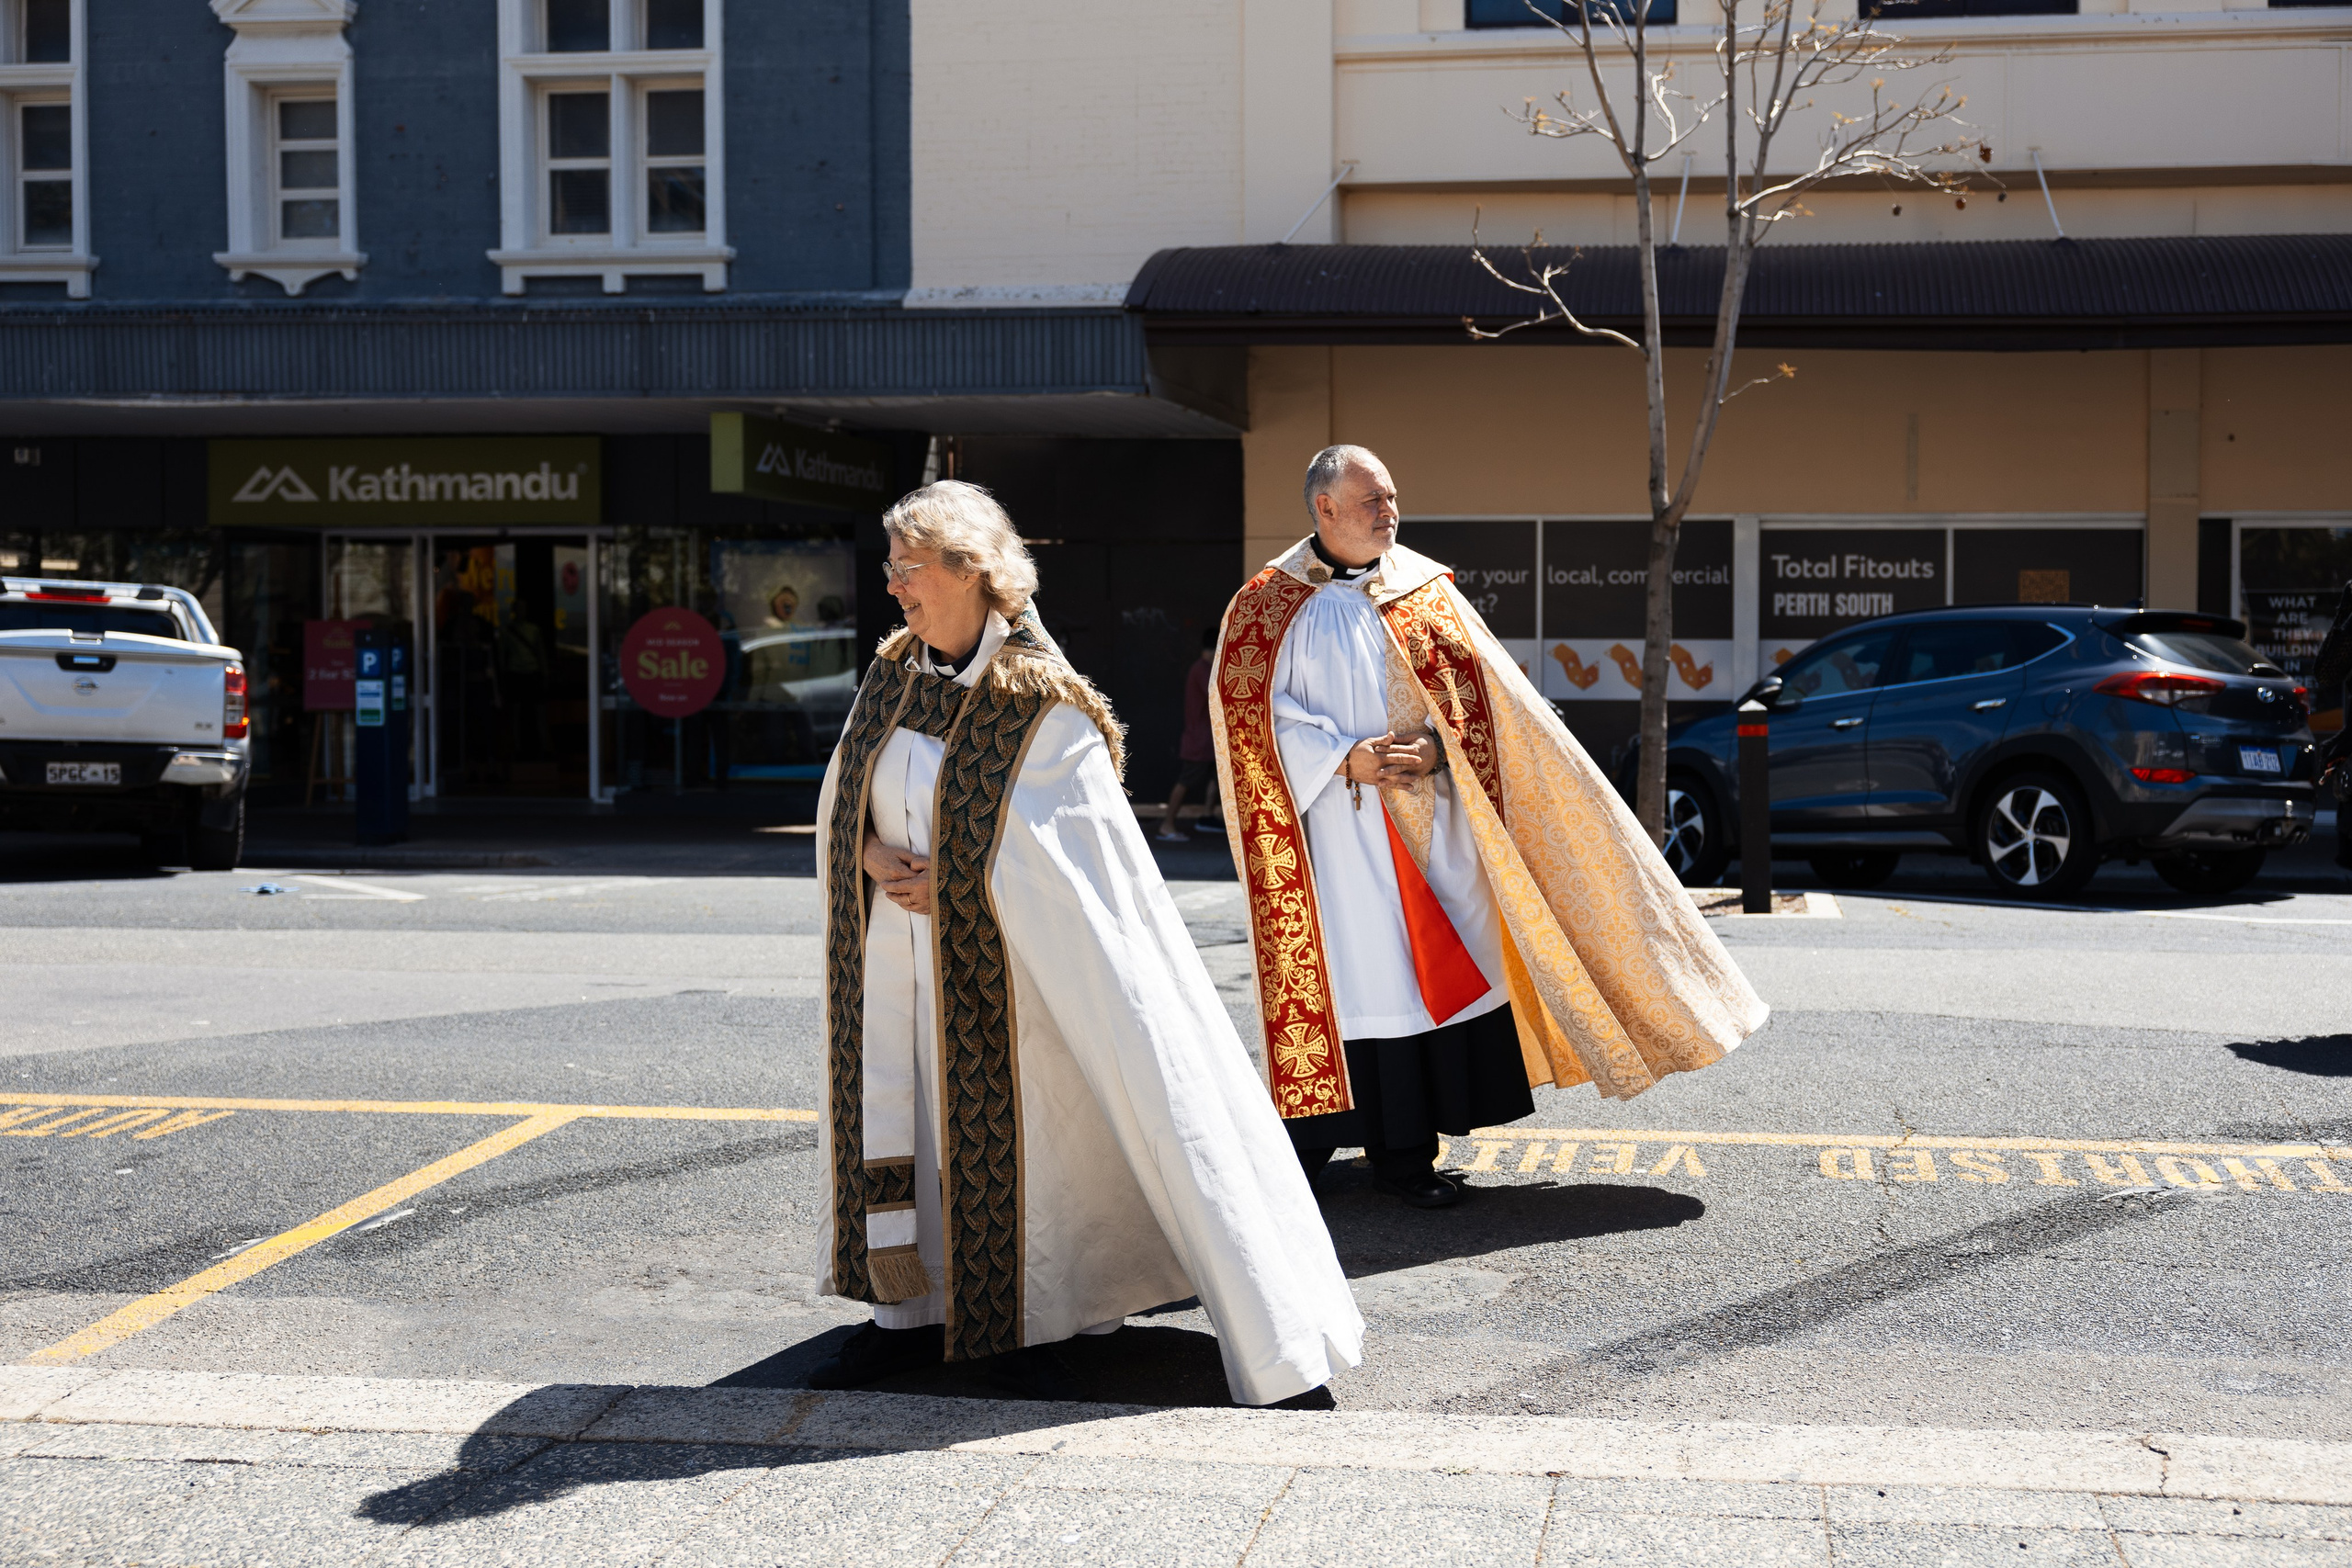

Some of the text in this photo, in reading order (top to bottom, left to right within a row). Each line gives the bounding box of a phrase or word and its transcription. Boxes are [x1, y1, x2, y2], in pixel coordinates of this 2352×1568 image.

[794, 446, 886, 492] Kathmandu
[328, 461, 579, 502] Kathmandu
[1450, 564, 1529, 589] or your
[1547, 564, 1730, 587] local, comercial
[1770, 554, 1935, 579] Total Fitouts
[1773, 592, 1894, 617] PERTH SOUTH
[2267, 595, 2317, 609] WHAT
[2277, 611, 2309, 625] ARE
[2272, 627, 2313, 641] THEY
[363, 650, 378, 673] P
[2256, 643, 2320, 657] BUILDIN
[638, 649, 709, 680] Sale
[2283, 660, 2301, 672] IN
[1434, 1139, 1707, 1179] VEHI
